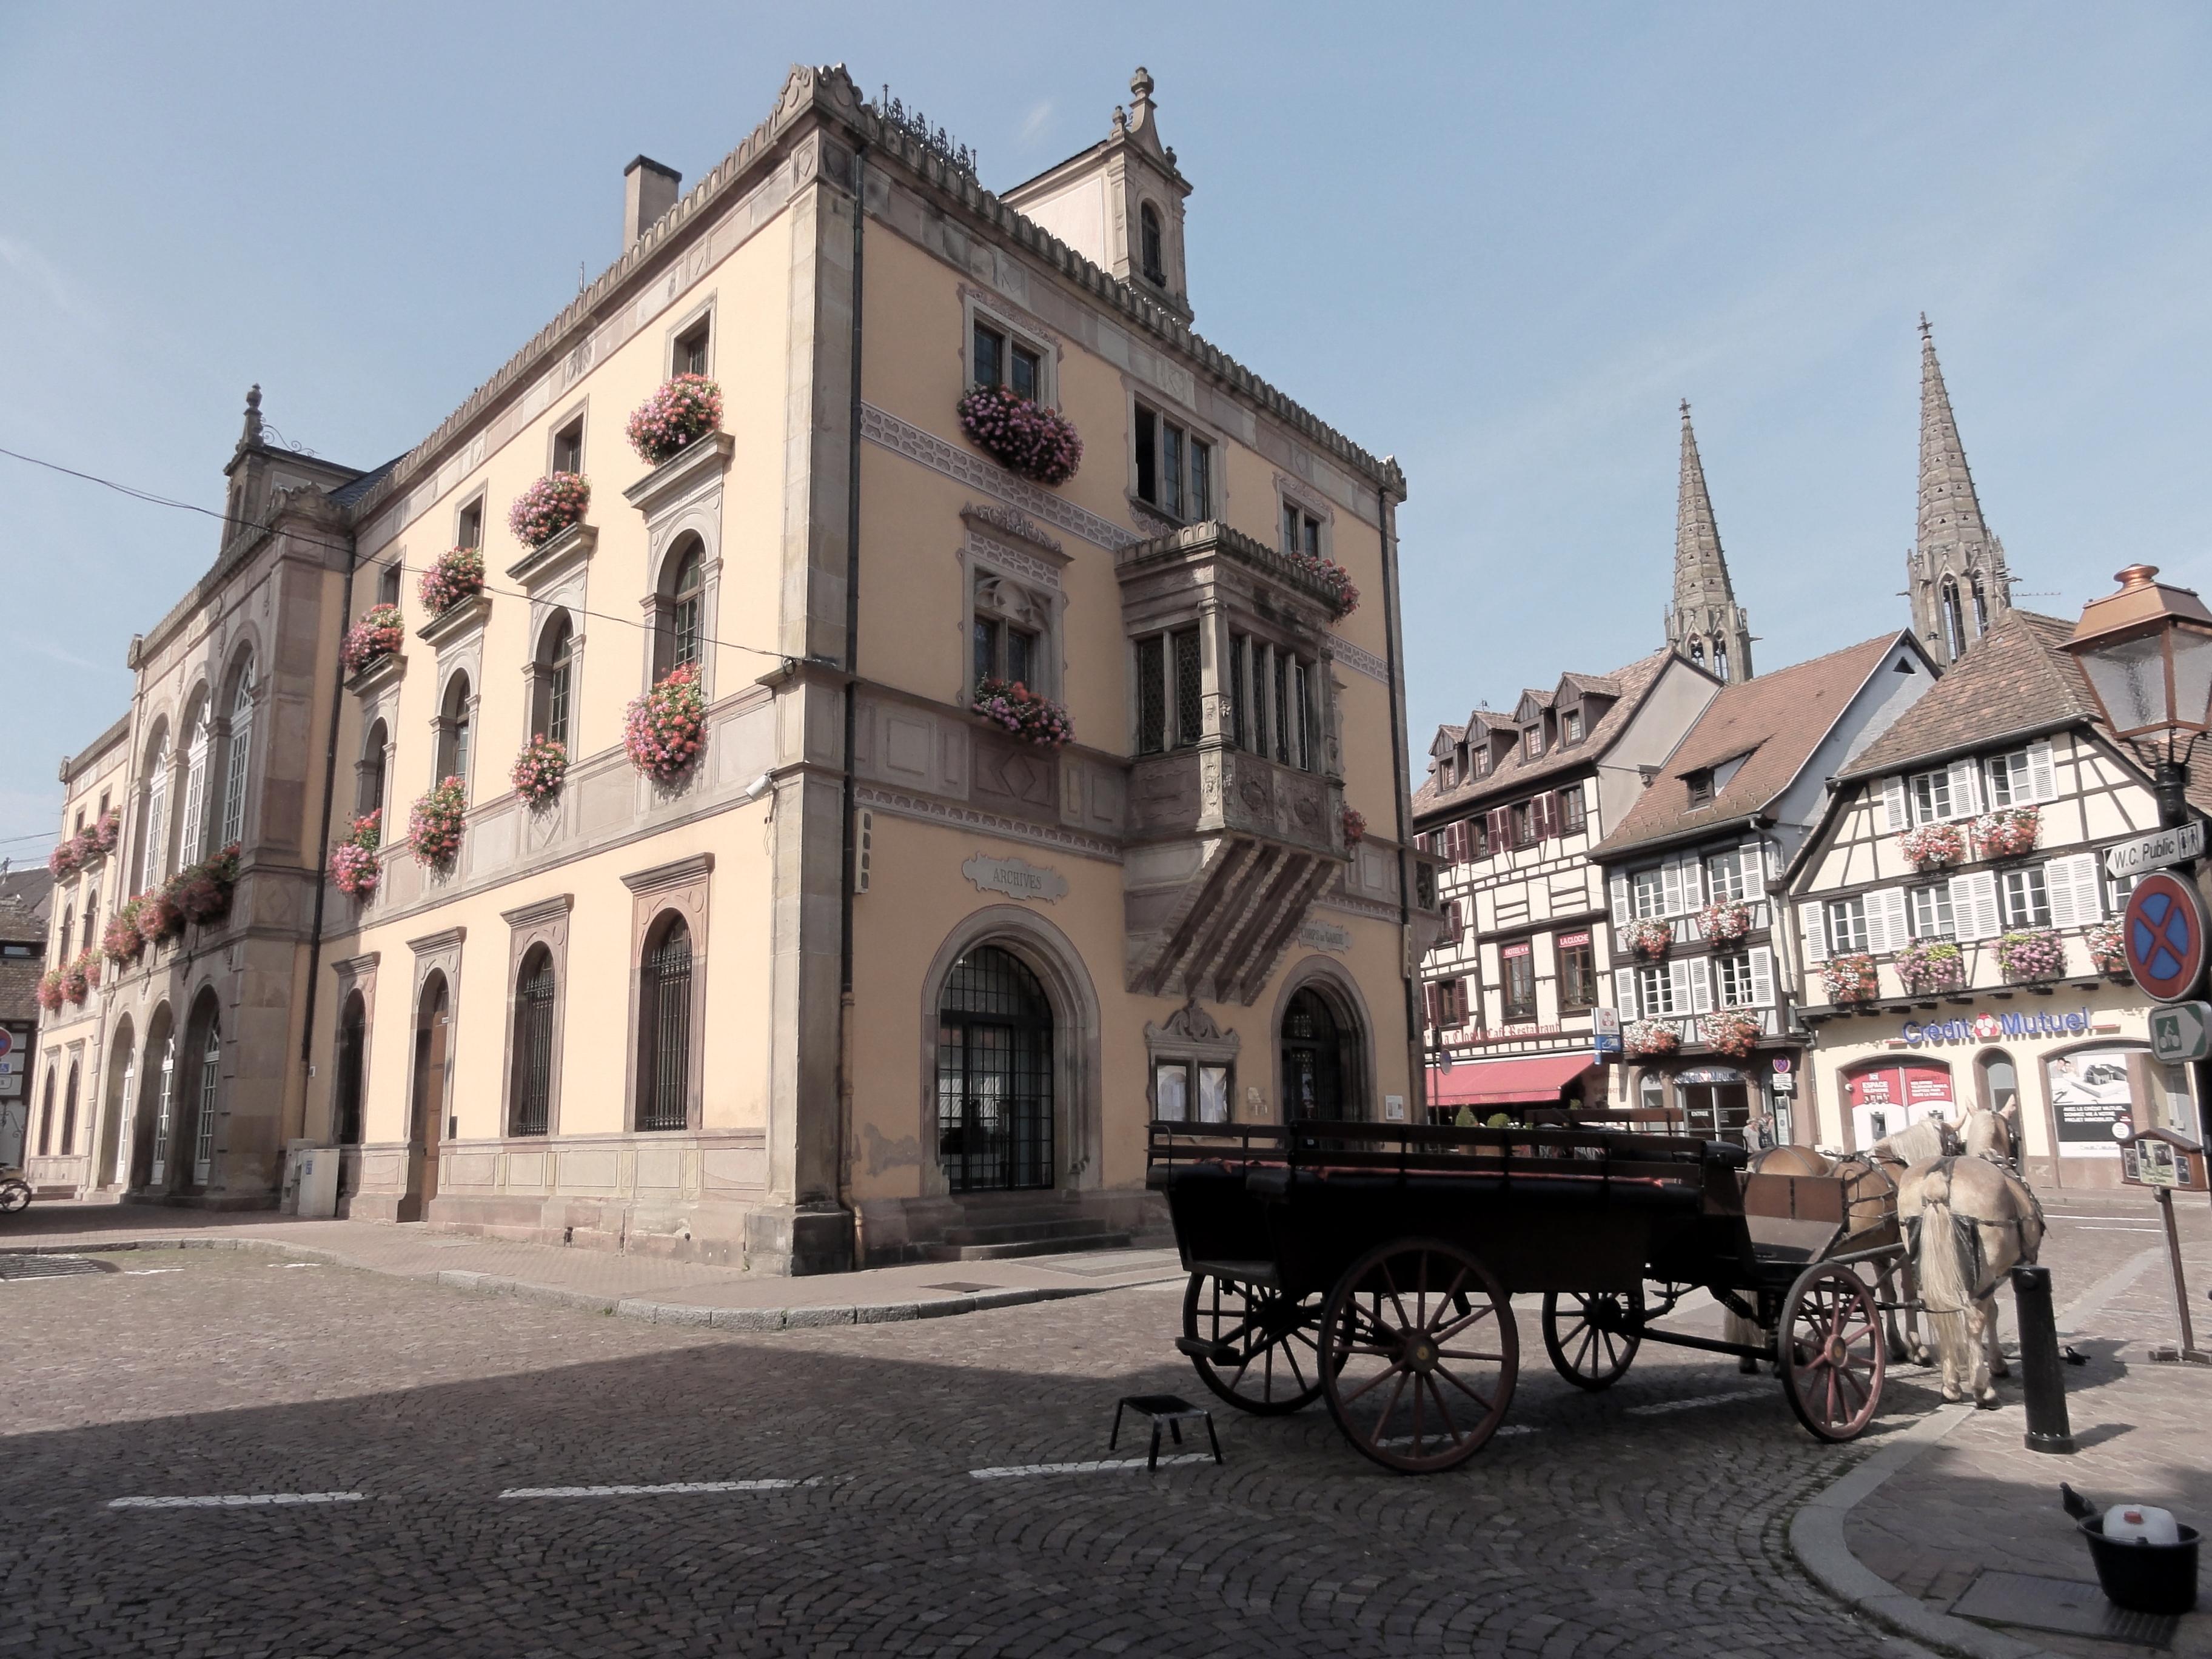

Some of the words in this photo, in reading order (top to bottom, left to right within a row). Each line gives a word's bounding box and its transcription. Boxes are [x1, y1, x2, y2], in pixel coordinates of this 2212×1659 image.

[2114, 847, 2139, 870] W.C.
[2142, 837, 2174, 862] Public
[993, 868, 1042, 890] ARCHIVES
[1300, 928, 1320, 941] CORPS
[1567, 934, 1589, 944] CLOCHE
[1505, 947, 1521, 956] HOTEL
[1903, 1019, 1971, 1044] Crédit
[2000, 1007, 2091, 1036] Mutuel
